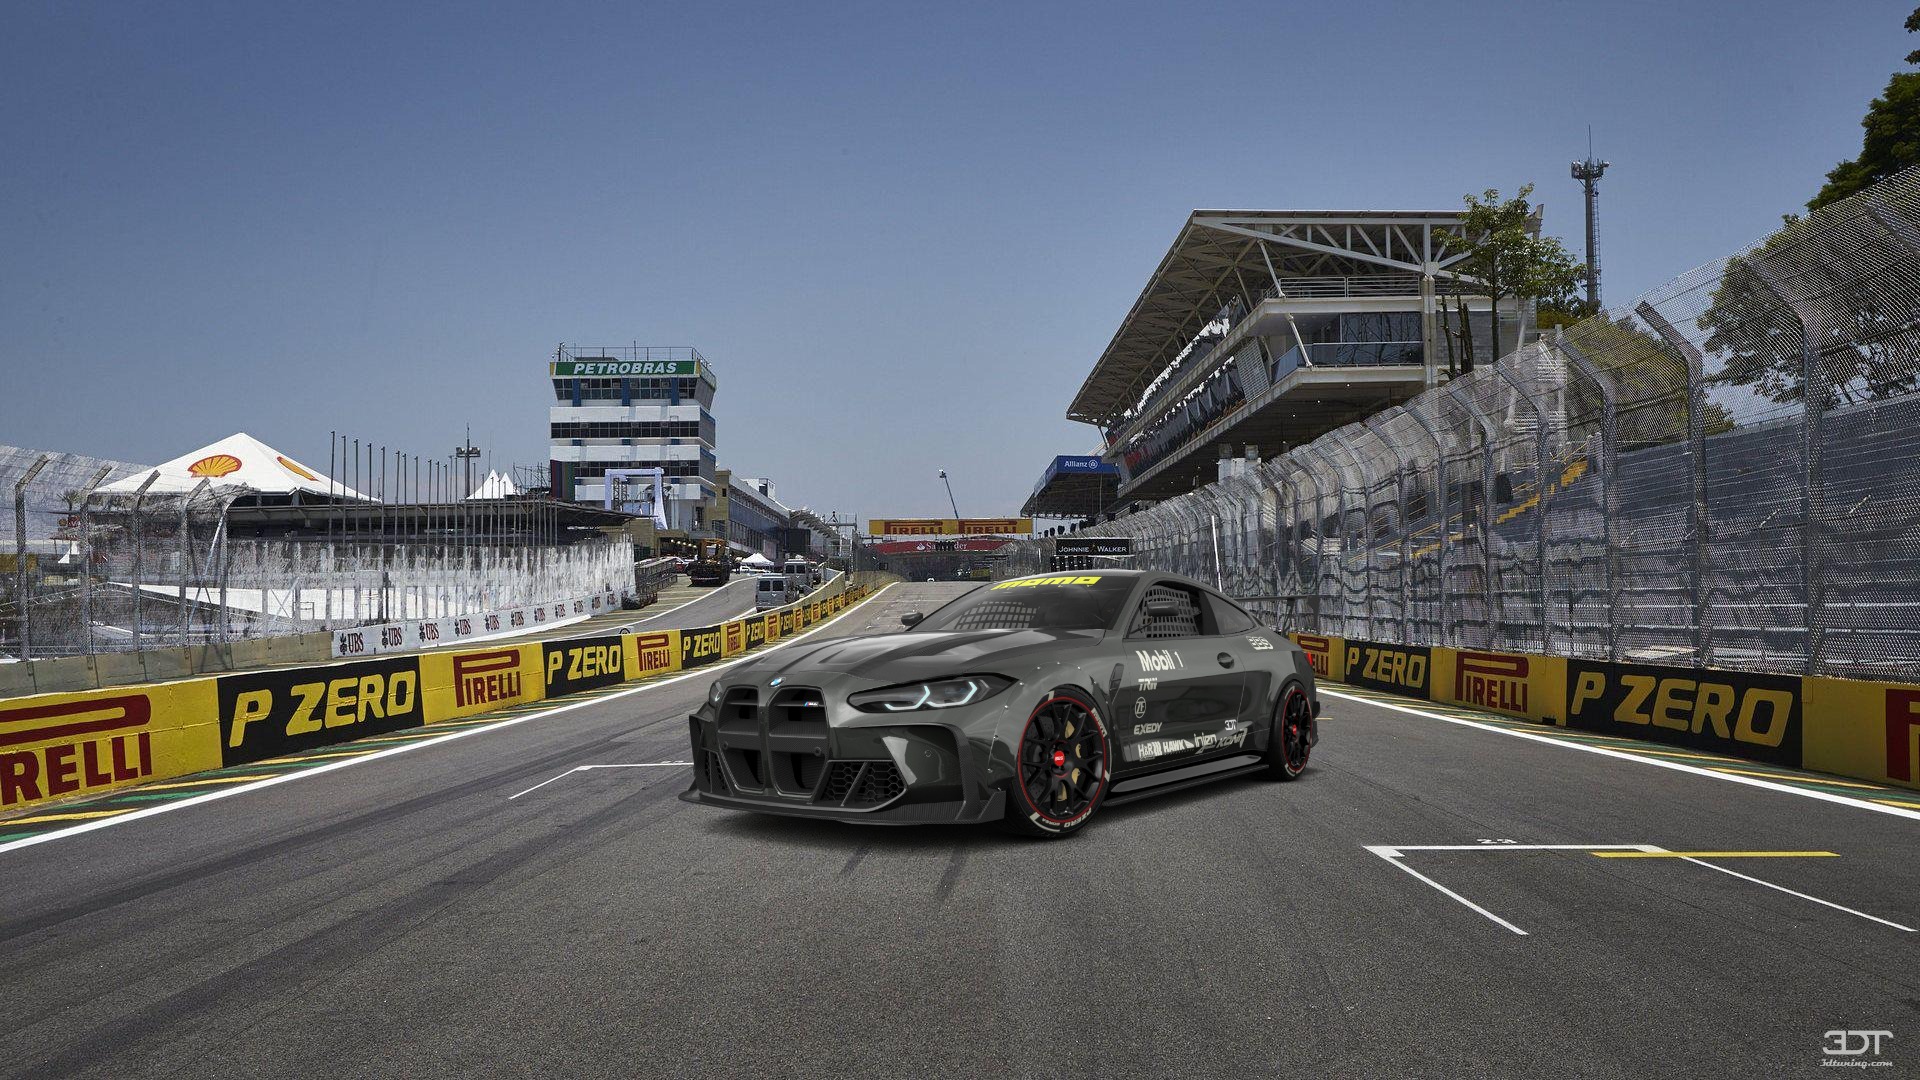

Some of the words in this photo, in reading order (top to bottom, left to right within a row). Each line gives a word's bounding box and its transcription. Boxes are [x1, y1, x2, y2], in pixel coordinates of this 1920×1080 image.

[574, 362, 677, 375] PETROBRAS
[1064, 460, 1088, 468] Allianz
[884, 521, 943, 535] PIRELLI
[958, 520, 1017, 534] PIRELLI
[926, 541, 967, 550] Sader
[1058, 545, 1089, 553] JOHNNIE
[1097, 545, 1128, 553] WALKER
[425, 622, 440, 640] UBS
[459, 618, 471, 635] UBS
[347, 632, 364, 654] UBS
[387, 626, 403, 647] UBS
[683, 636, 691, 660] P
[693, 631, 720, 657] ZERO
[637, 633, 671, 672] PIRELLI
[1135, 650, 1175, 671] Mobil
[1174, 651, 1184, 668] 1
[548, 650, 563, 685] P
[567, 645, 621, 681] ZERO
[1346, 647, 1360, 675] P
[1362, 648, 1426, 689] ZERO
[453, 649, 521, 708] PIRELLI
[1455, 652, 1529, 713] PIRELLI
[229, 688, 273, 748] P
[286, 670, 416, 737] ZERO
[1135, 700, 1146, 715] ZF
[1571, 671, 1606, 715] P
[1613, 674, 1794, 747] ZERO
[1134, 722, 1162, 735] EXEDY
[1163, 740, 1185, 753] HAWK
